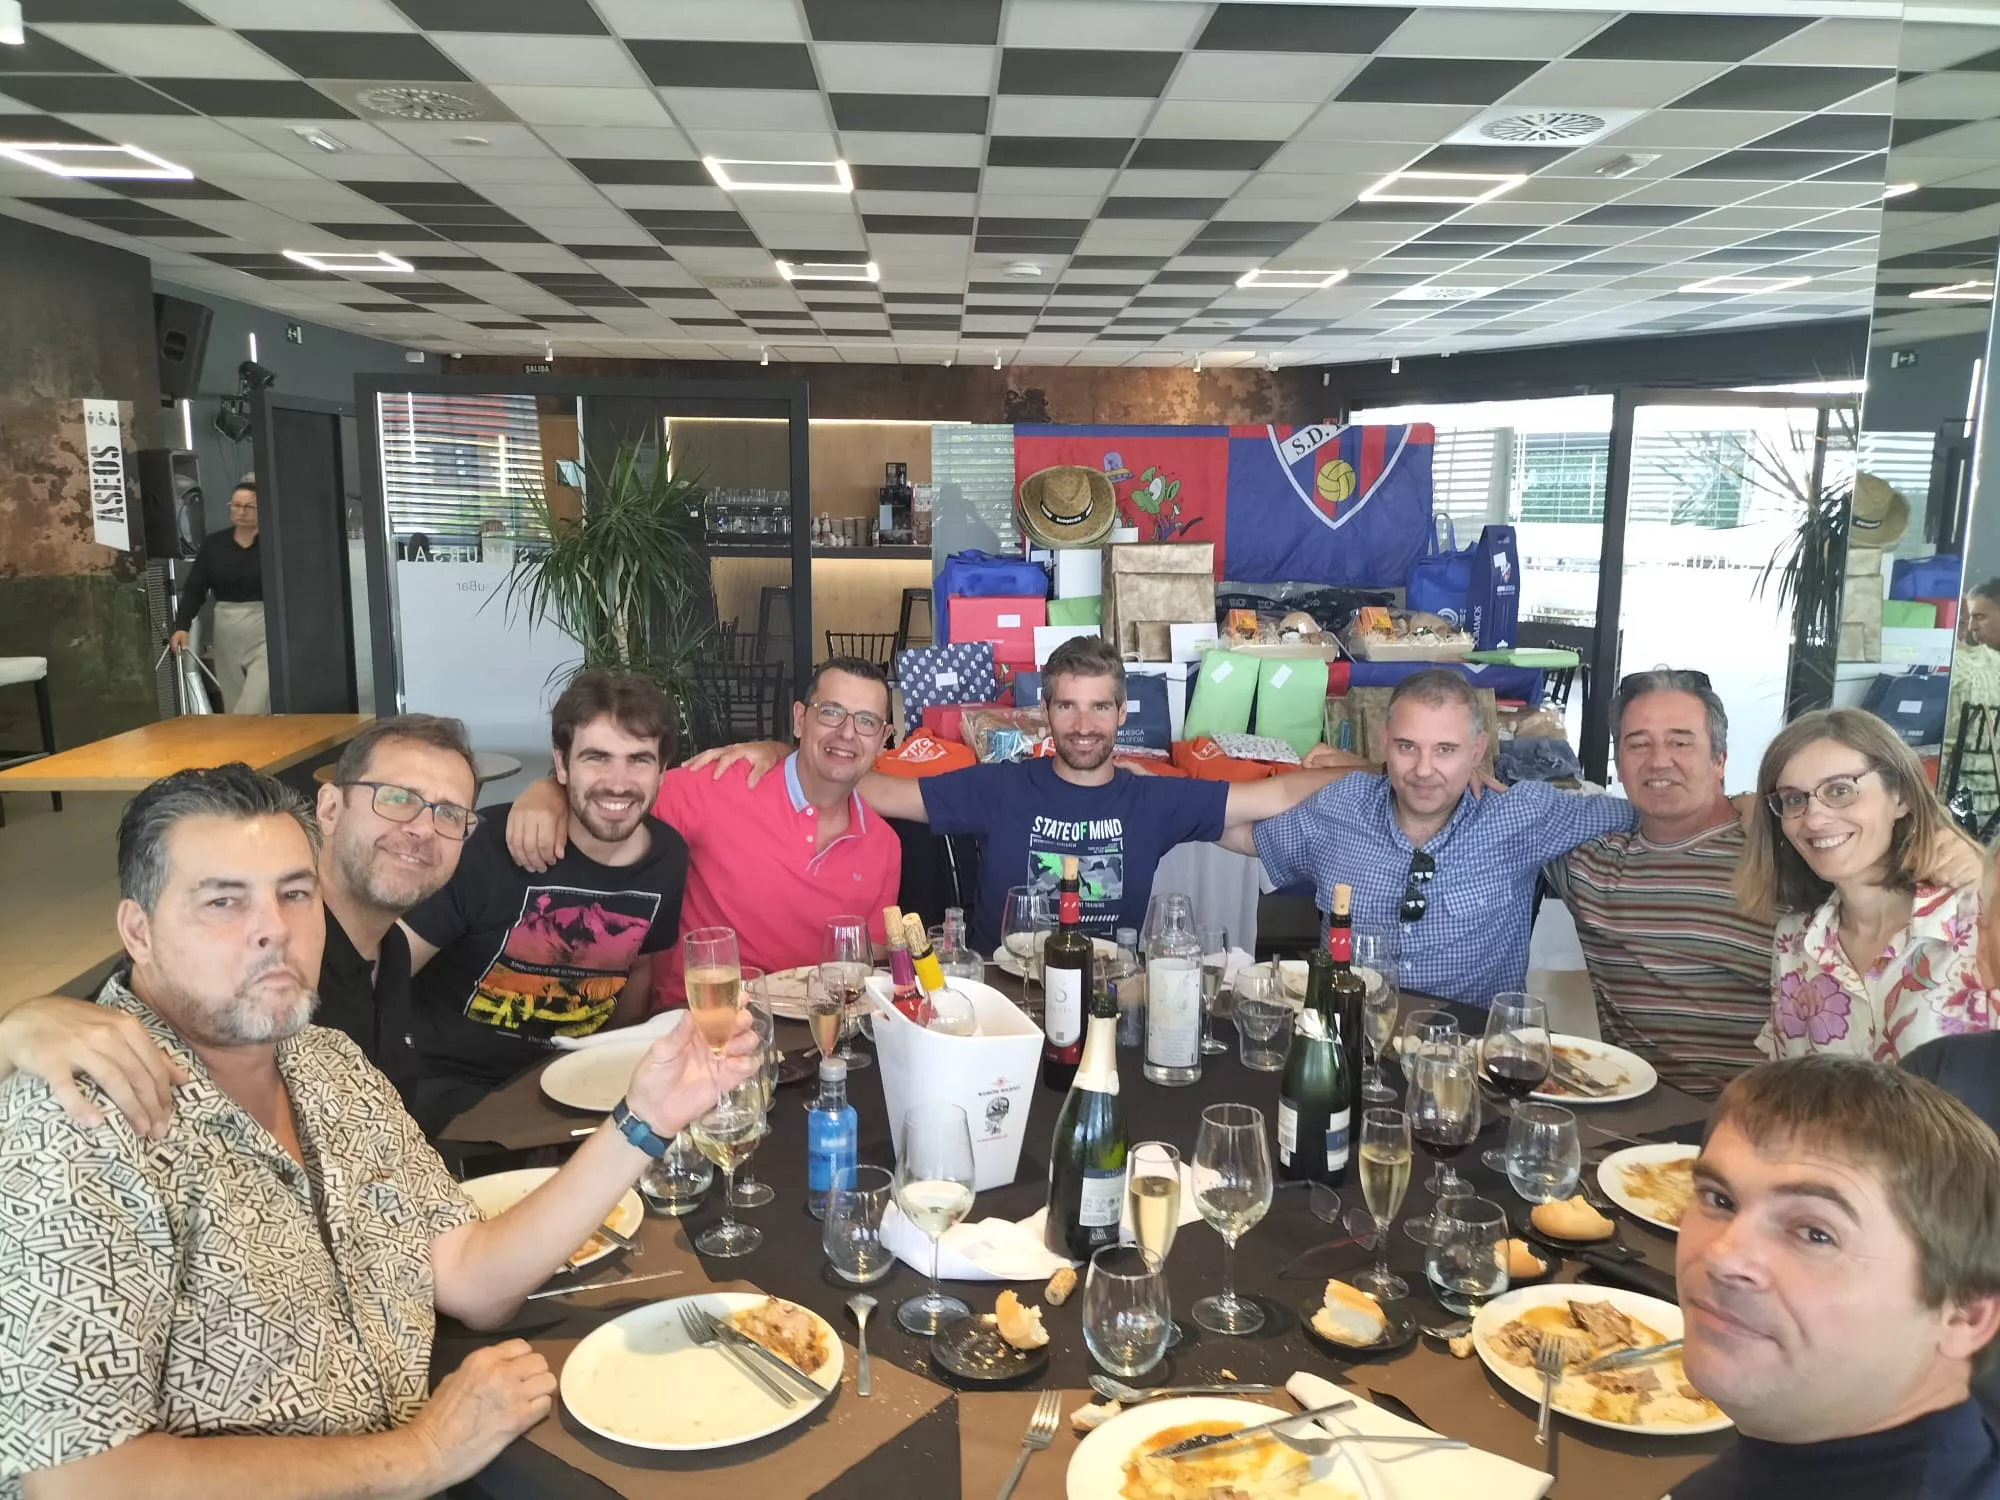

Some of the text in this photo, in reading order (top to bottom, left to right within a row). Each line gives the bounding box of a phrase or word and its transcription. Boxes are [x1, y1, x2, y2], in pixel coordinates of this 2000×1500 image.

[90, 446, 124, 523] ASEOS
[1032, 815, 1123, 841] STATE OF MIND
